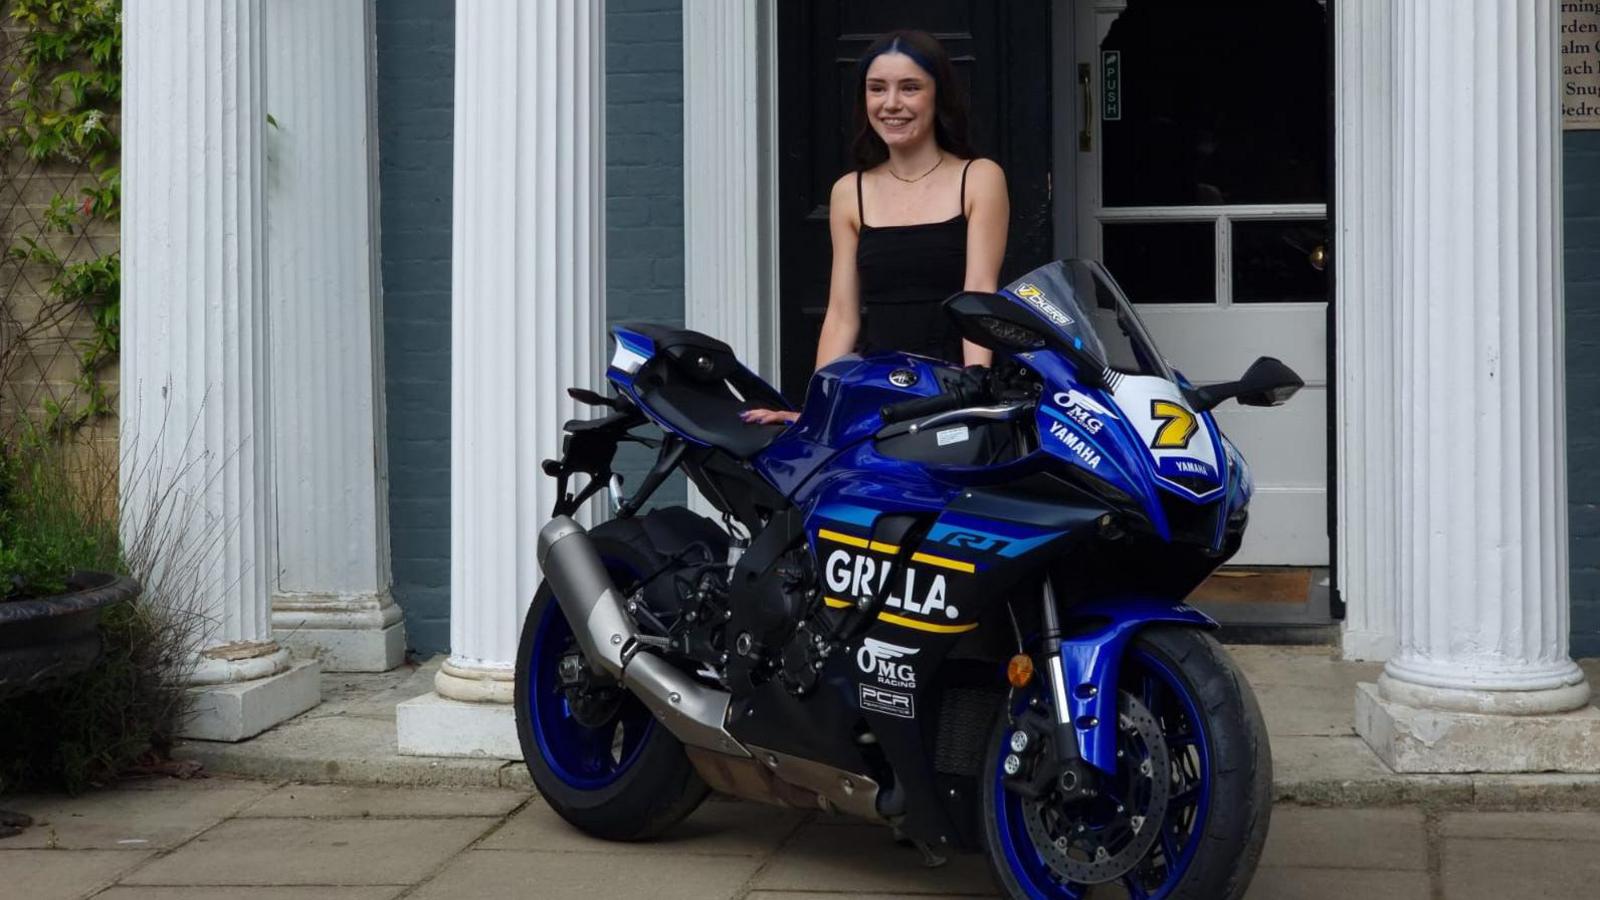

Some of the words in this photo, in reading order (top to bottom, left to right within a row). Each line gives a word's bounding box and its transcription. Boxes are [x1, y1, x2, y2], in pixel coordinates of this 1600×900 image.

[1107, 67, 1117, 114] PUSH
[1566, 81, 1600, 98] Snu
[1054, 390, 1105, 432] OMG
[1150, 399, 1199, 449] 7
[1049, 421, 1101, 469] YAMAHA
[1175, 461, 1208, 477] YAMAHA
[857, 645, 917, 682] OMG
[877, 676, 916, 688] RACING
[862, 687, 910, 708] PCR
